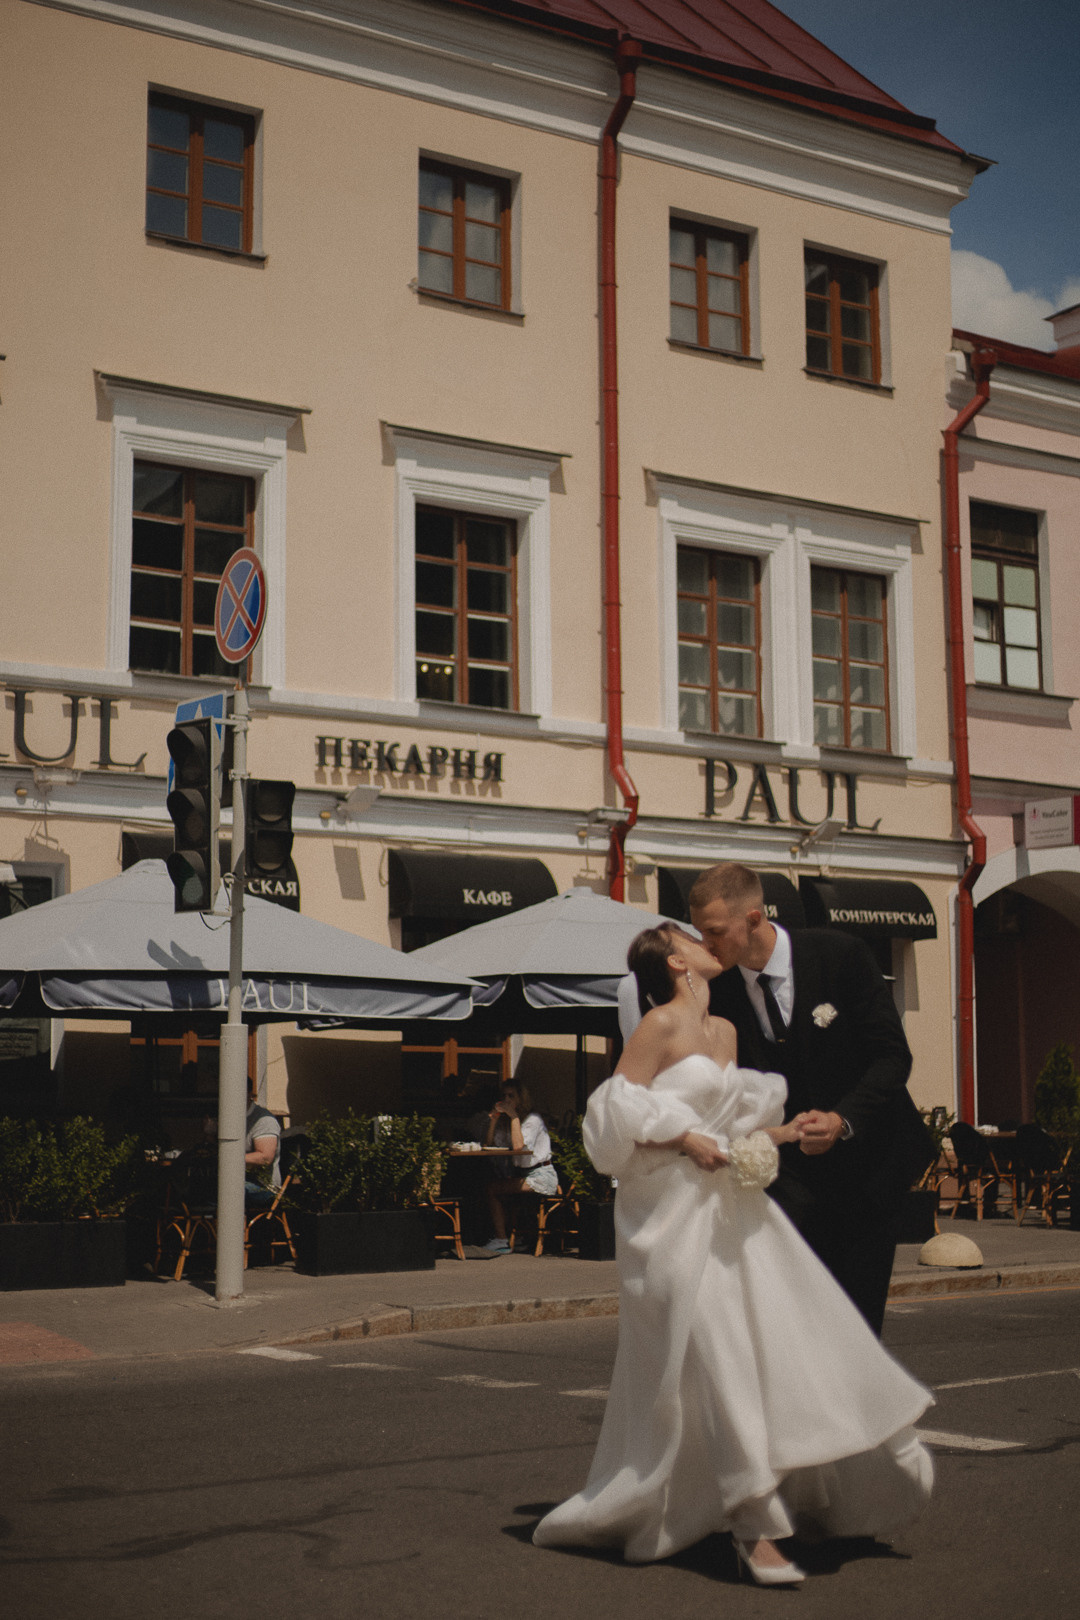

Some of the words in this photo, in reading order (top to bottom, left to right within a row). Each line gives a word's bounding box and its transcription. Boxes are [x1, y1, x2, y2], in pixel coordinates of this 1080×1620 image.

[0, 688, 148, 767] UL
[315, 735, 505, 782] ПЕКАРНЯ
[698, 757, 882, 832] PAUL
[244, 879, 298, 897] СКАЯ
[462, 888, 513, 906] КАФЕ
[829, 908, 936, 926] КОНДИТЕРСКАЯ
